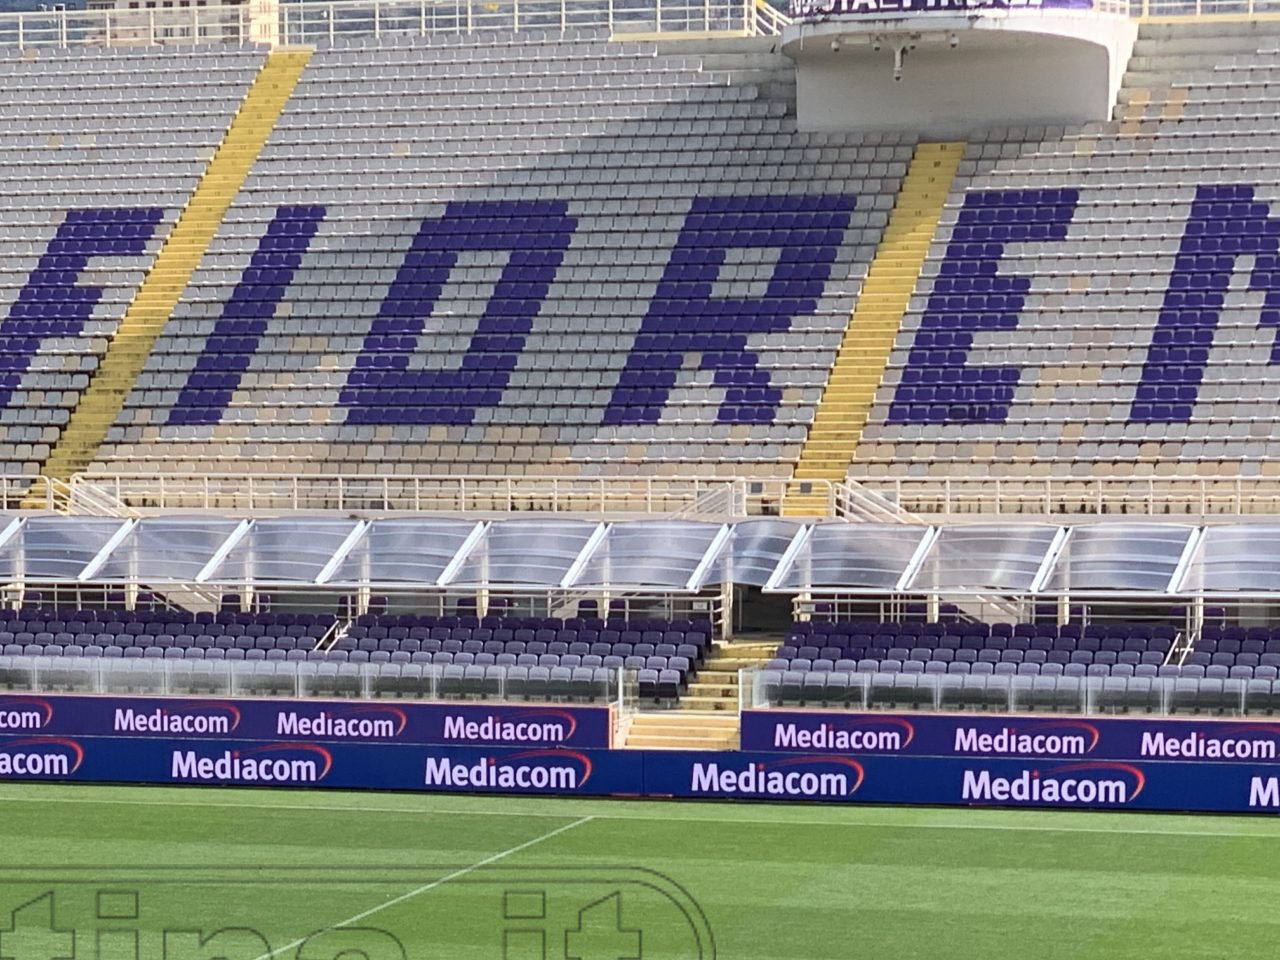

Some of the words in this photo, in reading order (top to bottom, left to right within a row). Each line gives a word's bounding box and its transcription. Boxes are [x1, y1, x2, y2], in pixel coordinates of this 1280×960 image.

[114, 708, 228, 733] Mediacom
[277, 711, 394, 737] Mediacom
[444, 716, 563, 741] Mediacom
[774, 723, 900, 750] Mediacom
[954, 727, 1085, 754] Mediacom
[1141, 732, 1276, 759] Mediacom
[172, 750, 316, 781] Mediacom
[425, 757, 576, 788] Mediacom
[691, 762, 847, 796] Mediacom
[962, 770, 1126, 803] Mediacom
